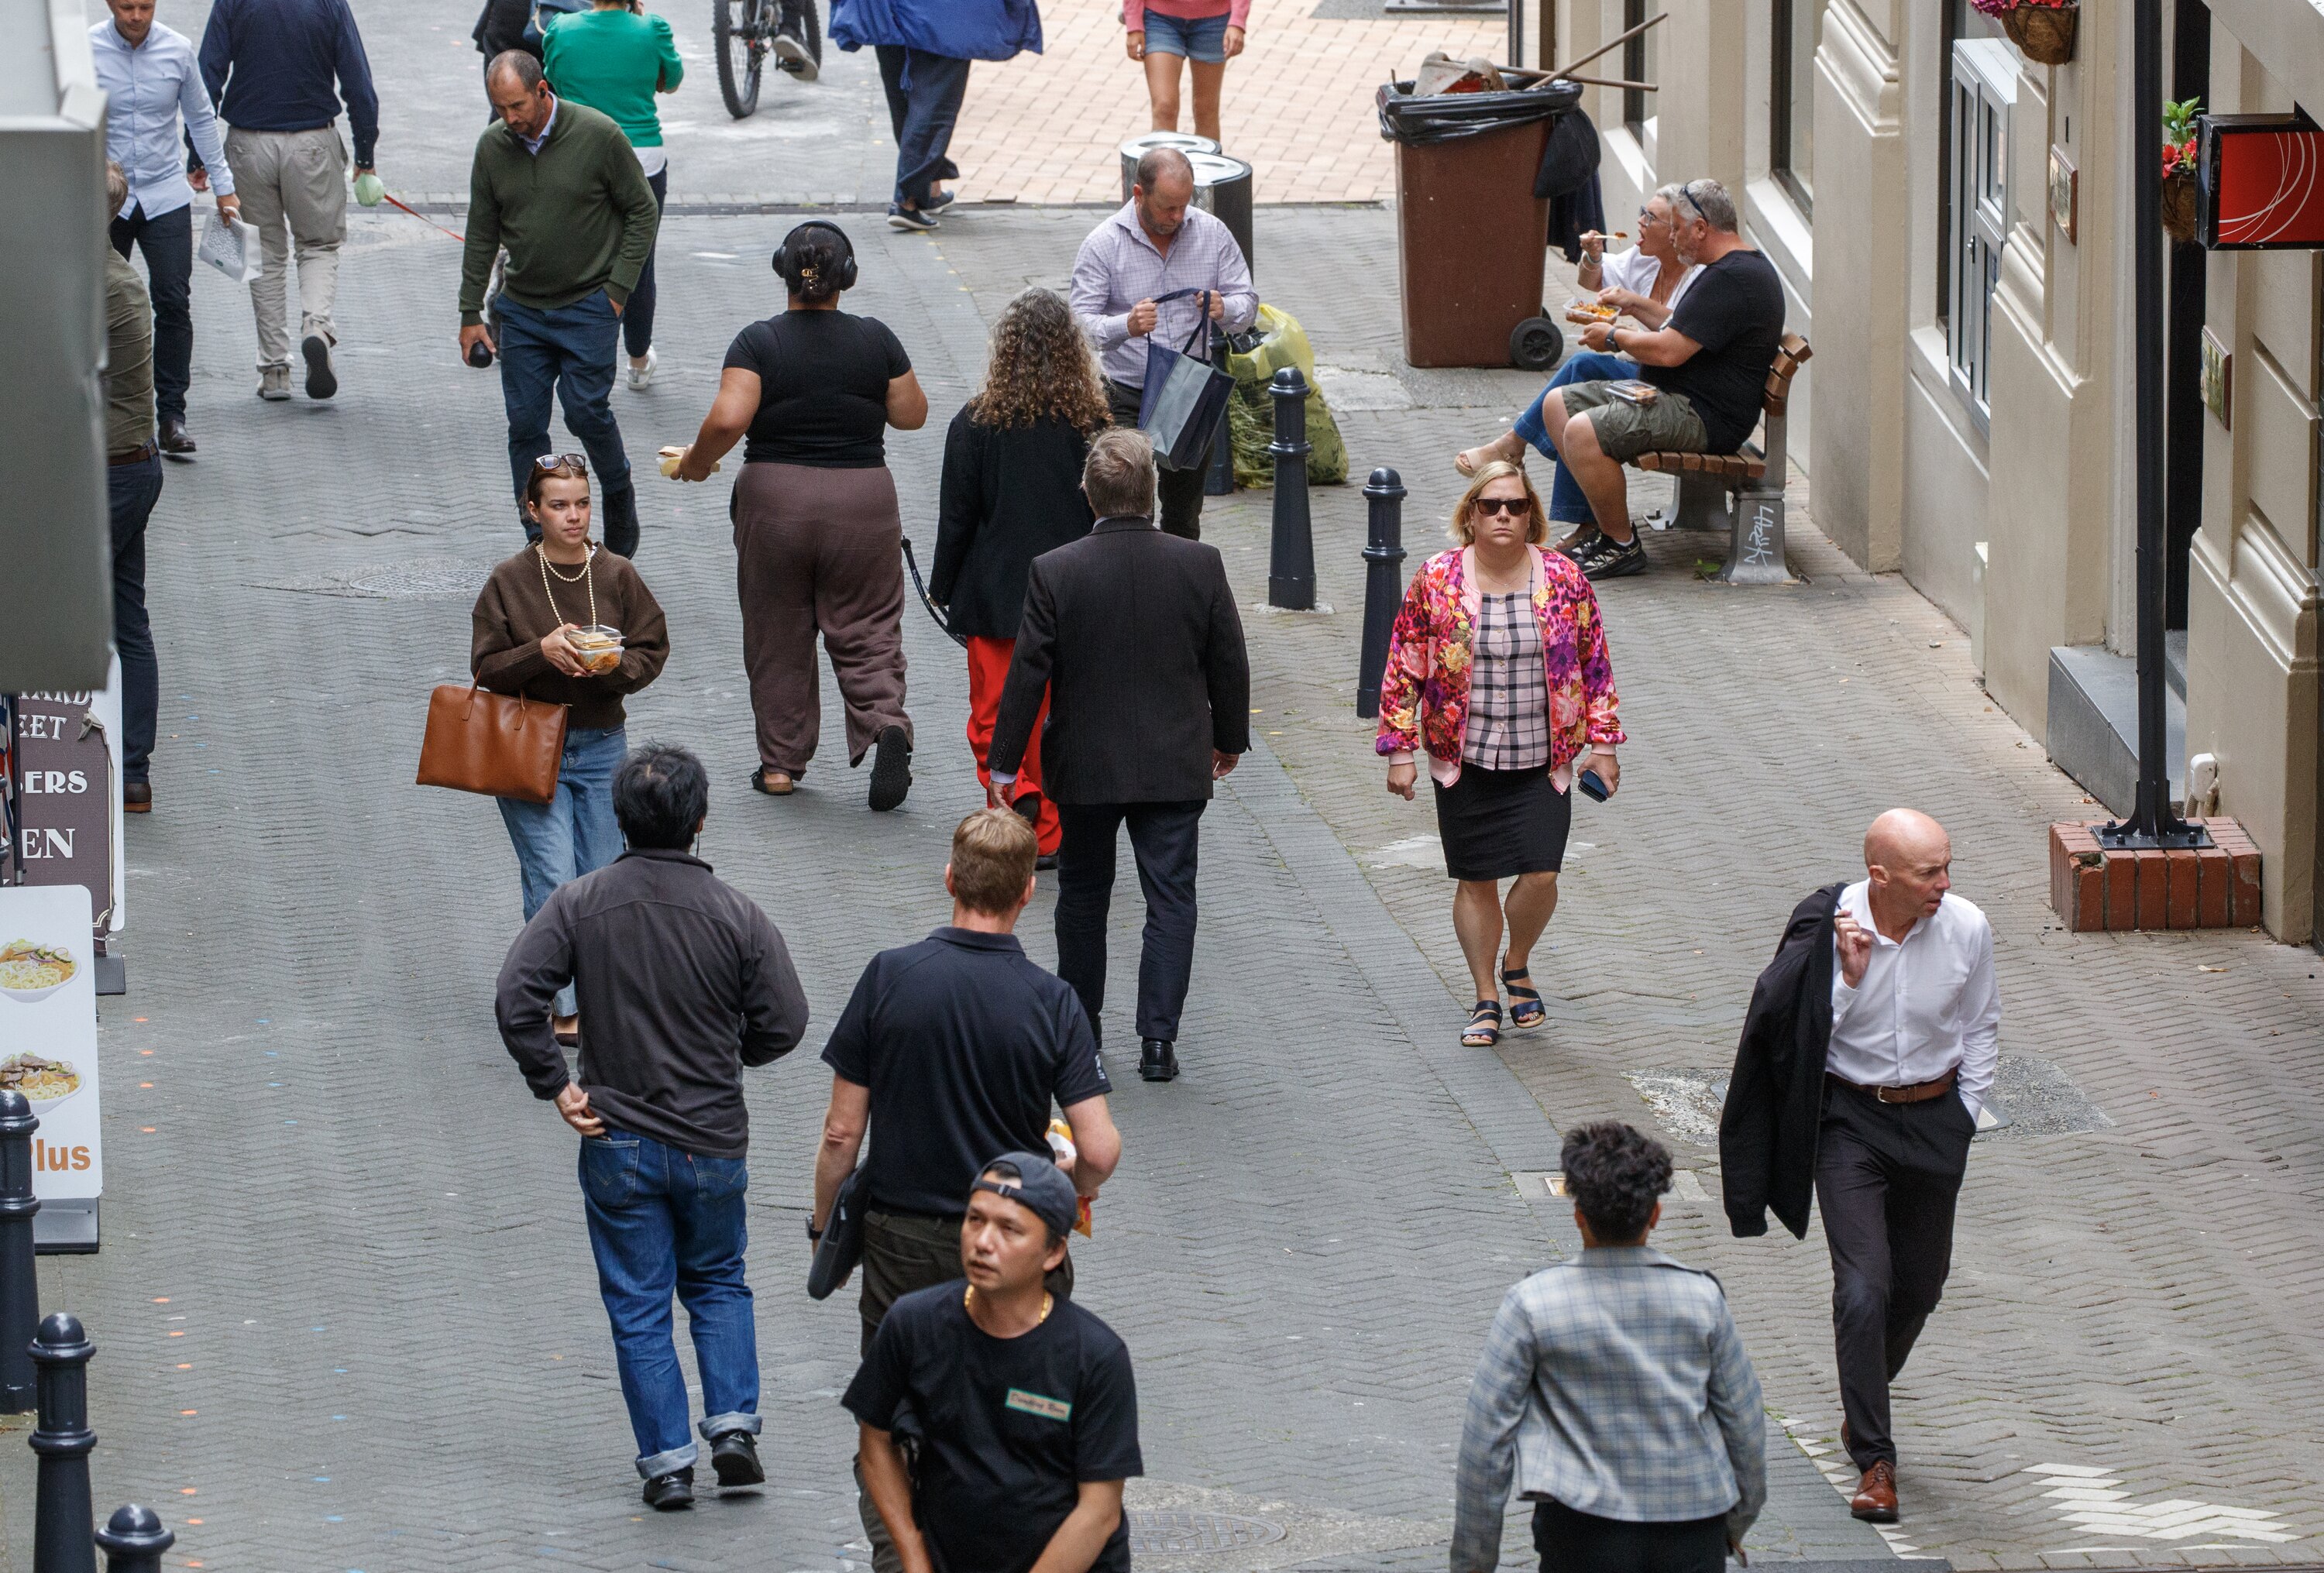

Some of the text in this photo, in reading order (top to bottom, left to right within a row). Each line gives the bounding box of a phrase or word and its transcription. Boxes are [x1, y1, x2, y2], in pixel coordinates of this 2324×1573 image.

[20, 771, 88, 794] ERS
[22, 828, 75, 859] EN
[30, 1139, 91, 1171] lus
